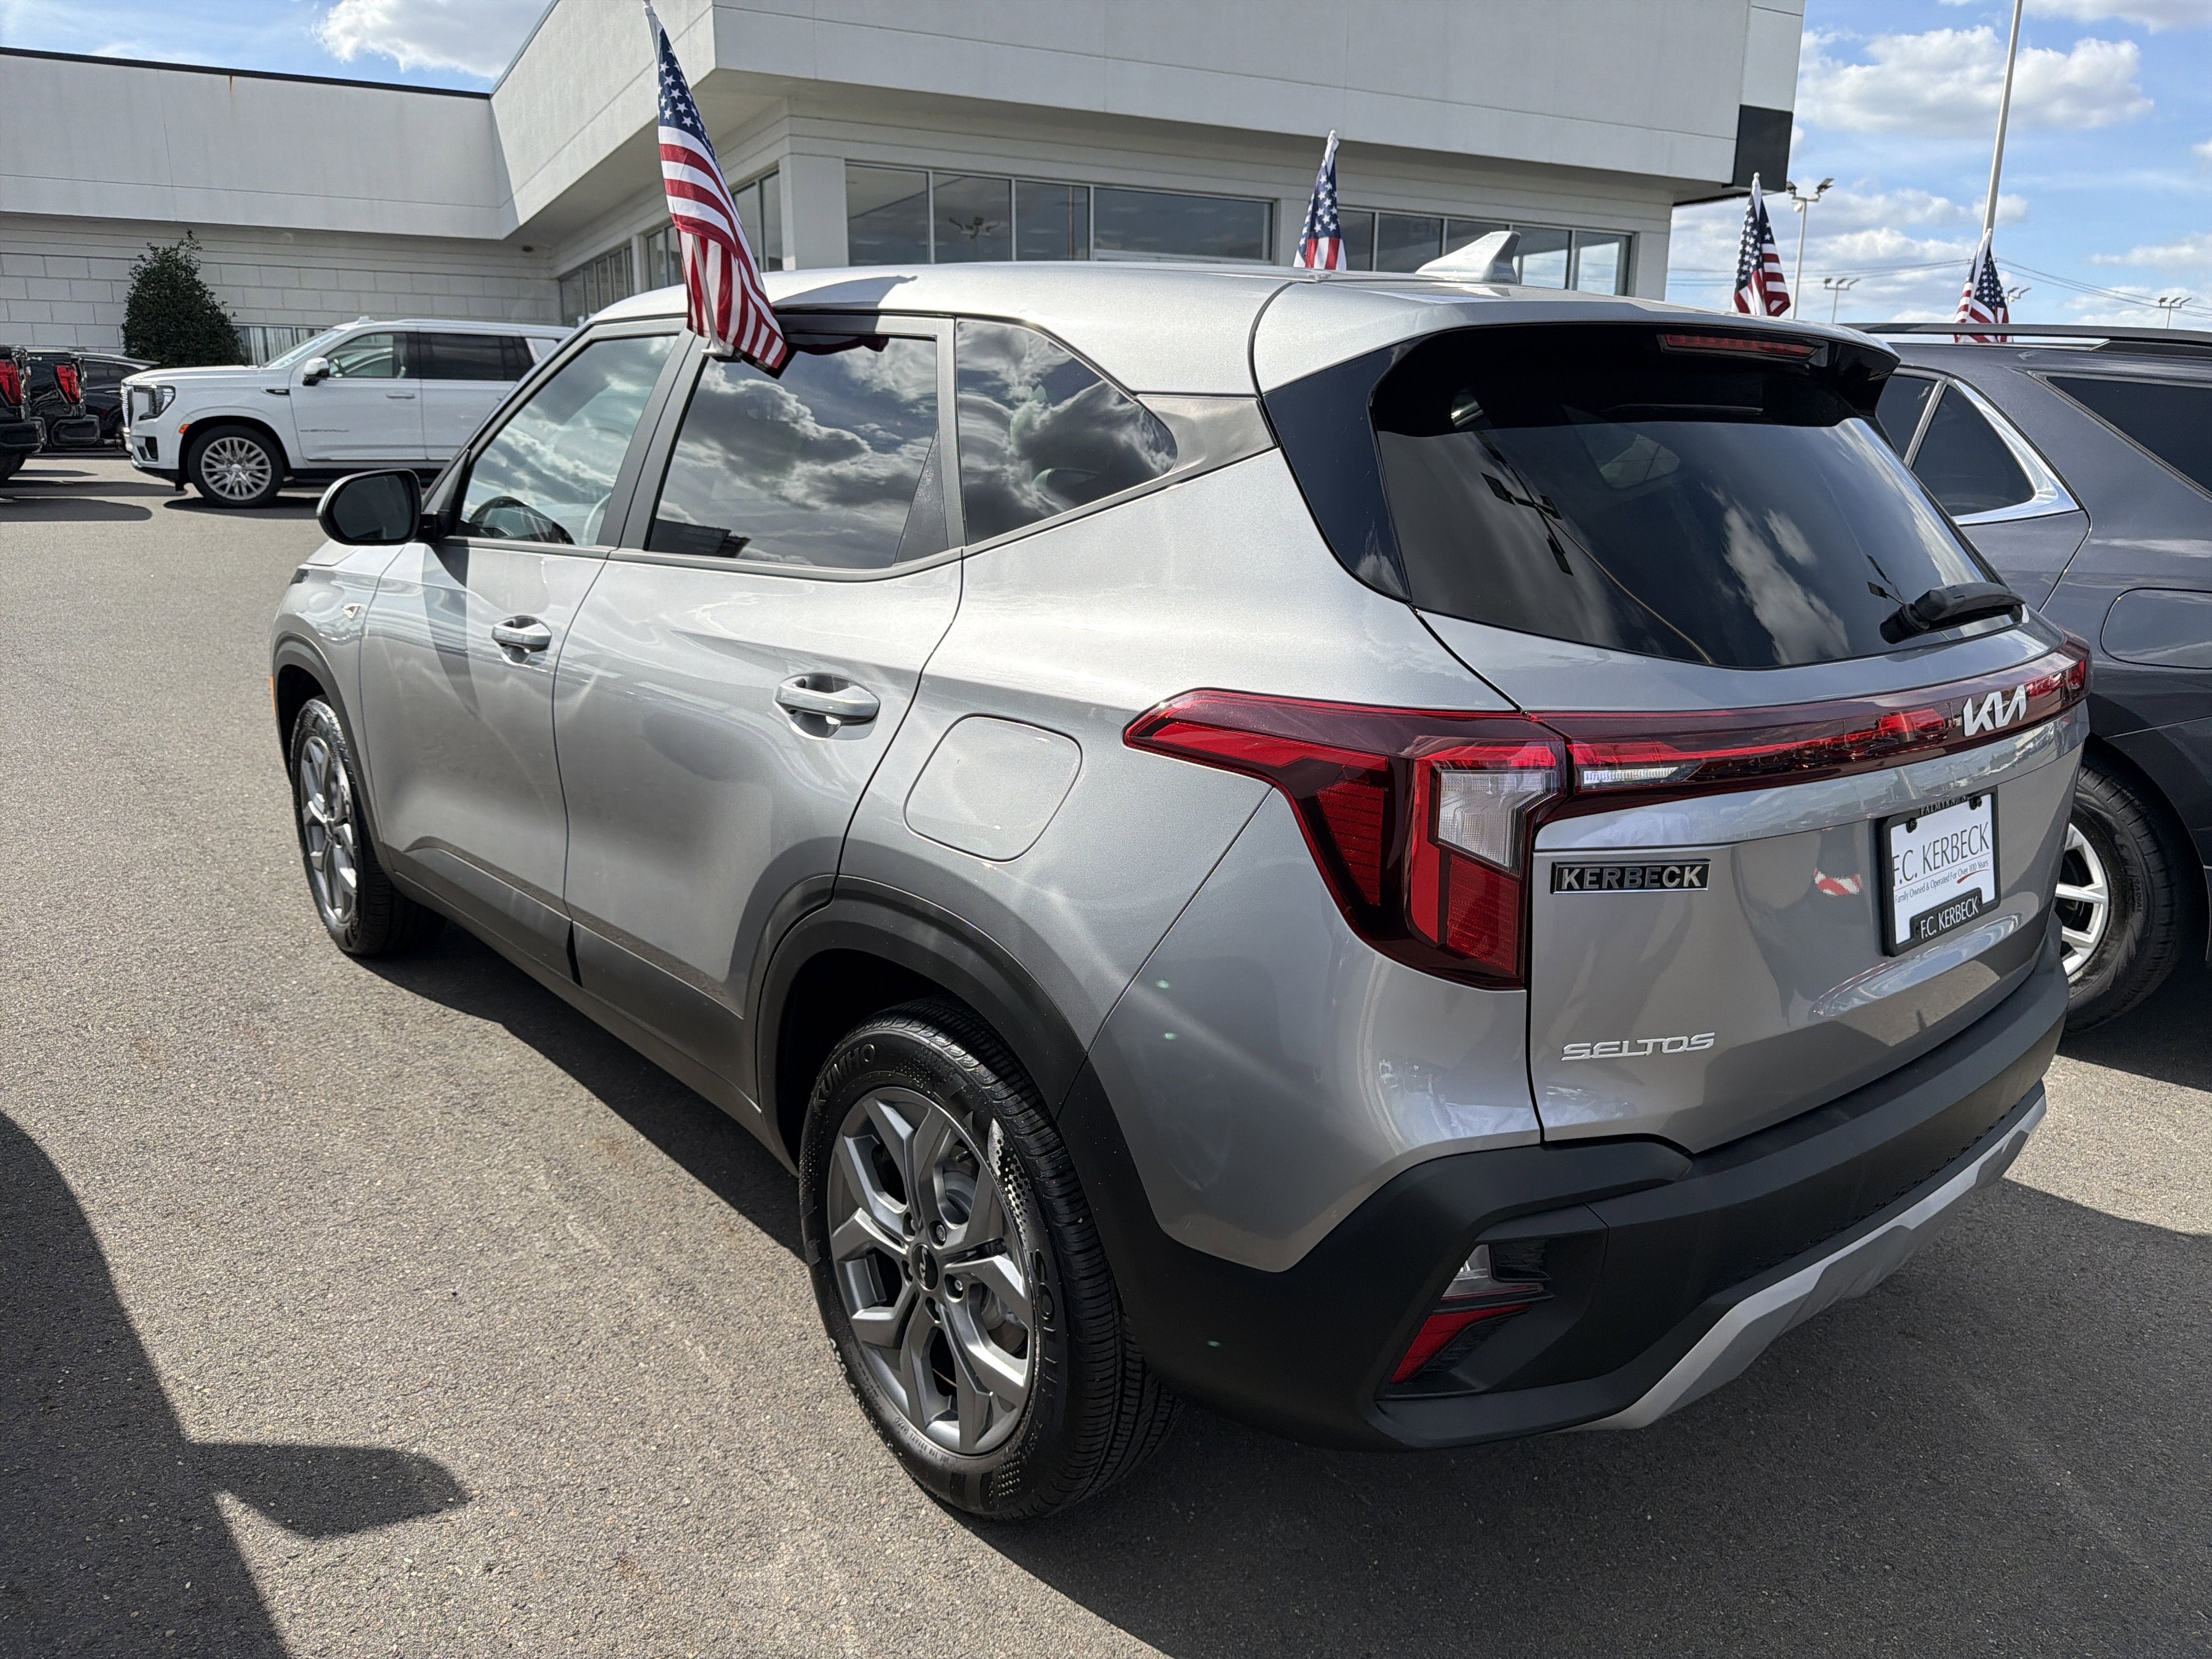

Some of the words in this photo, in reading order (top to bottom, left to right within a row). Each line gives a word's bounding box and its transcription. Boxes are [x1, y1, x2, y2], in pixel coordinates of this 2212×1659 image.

[1963, 685, 2026, 737] KIA
[1893, 849, 1917, 886] F.C.
[1923, 822, 1989, 874] KERBECK
[1561, 865, 1703, 890] KERBECK
[1895, 890, 1909, 904] Family
[1910, 882, 1926, 898] Owned
[1926, 882, 1929, 891] &
[1931, 872, 1950, 889] Operated
[1958, 866, 1968, 877] Over
[1977, 860, 1989, 870] Years
[1920, 916, 1937, 940] F.C.
[1938, 895, 1979, 931] KERBECK
[1561, 1031, 1716, 1061] SELTOS
[812, 1043, 876, 1117] KUMHO
